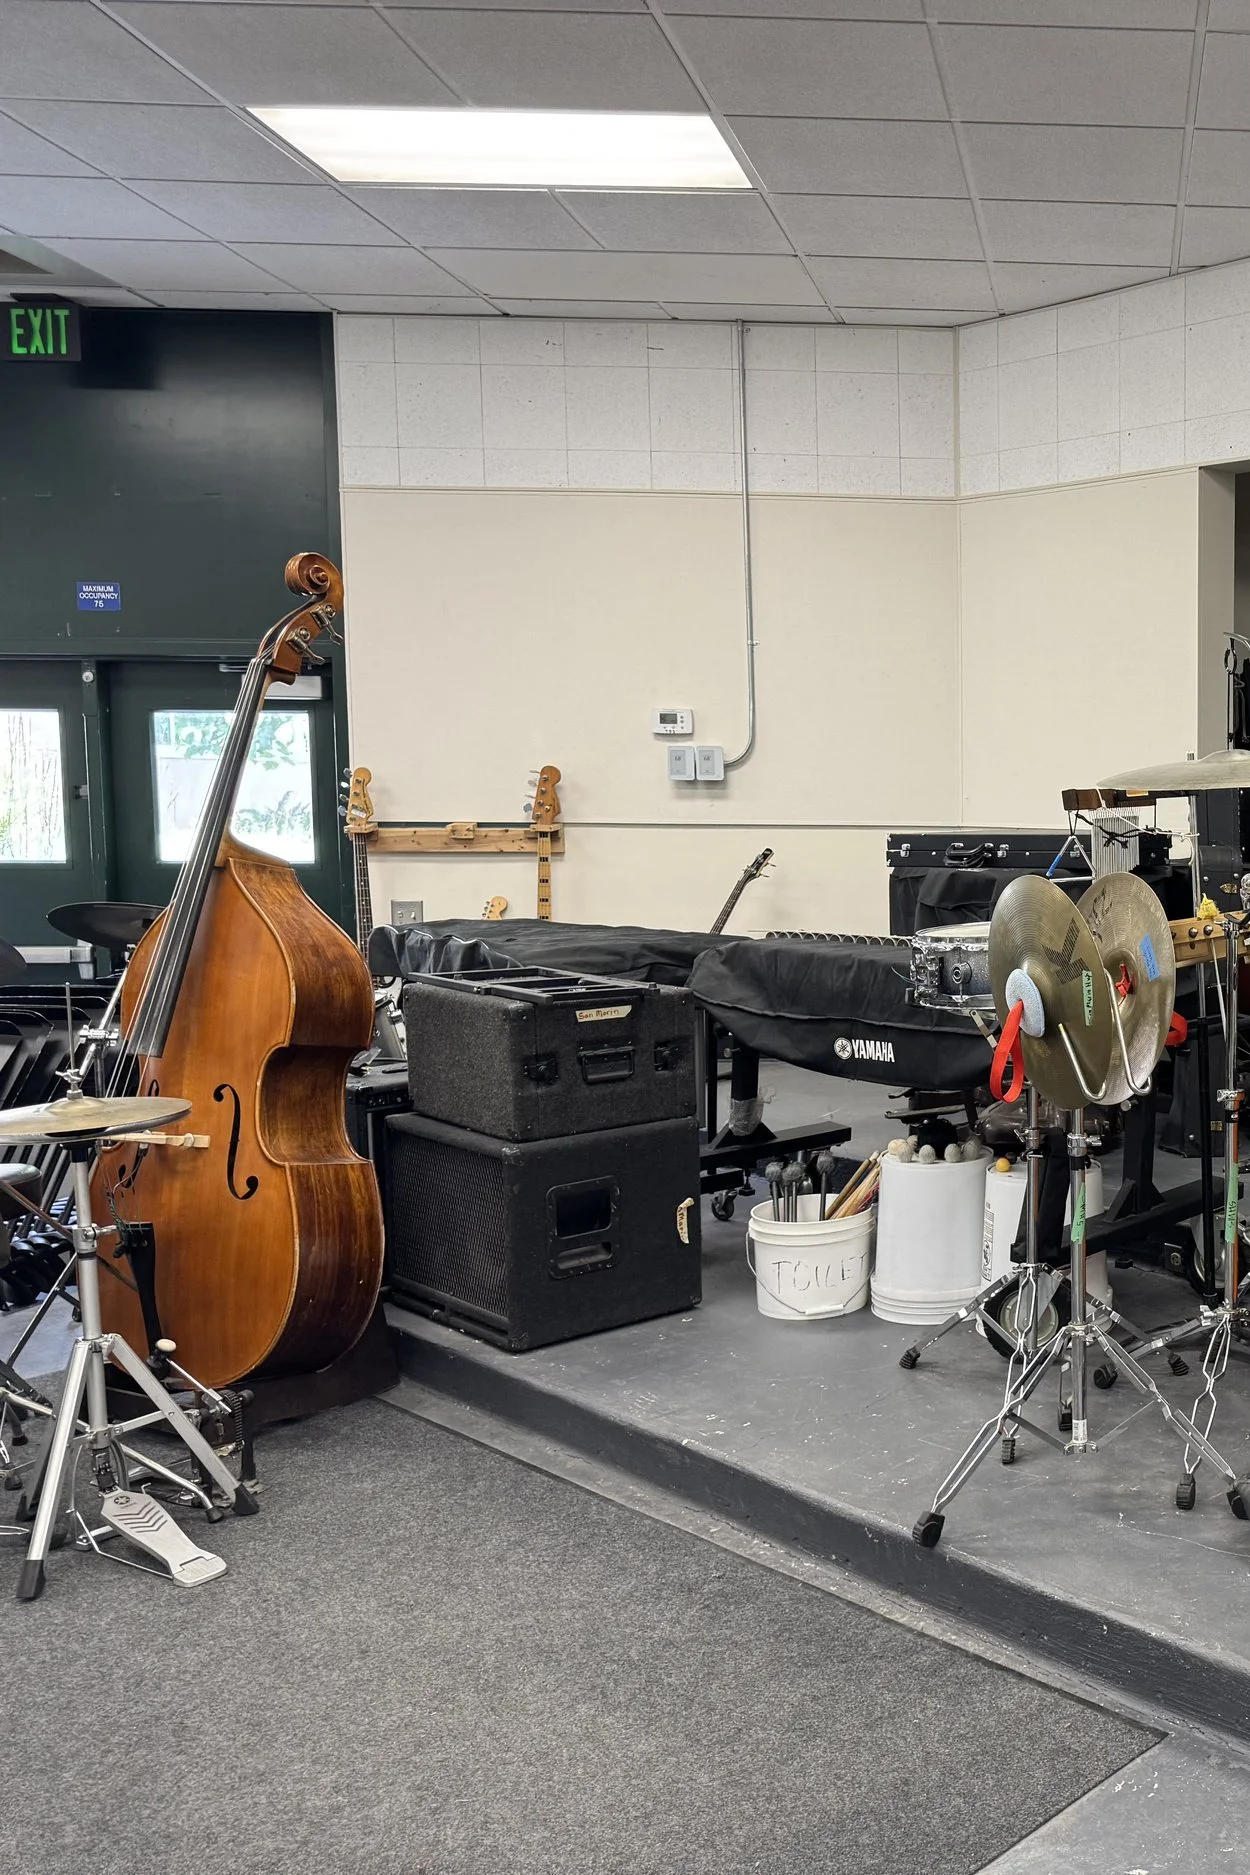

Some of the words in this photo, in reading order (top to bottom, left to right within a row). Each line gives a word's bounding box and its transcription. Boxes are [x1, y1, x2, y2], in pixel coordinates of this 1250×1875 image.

[10, 308, 70, 354] EXIT
[94, 600, 104, 608] 75
[578, 1012, 593, 1020] San
[595, 1009, 619, 1017] Marin
[852, 1039, 895, 1062] YAMAHA
[772, 1252, 867, 1294] TOILET
